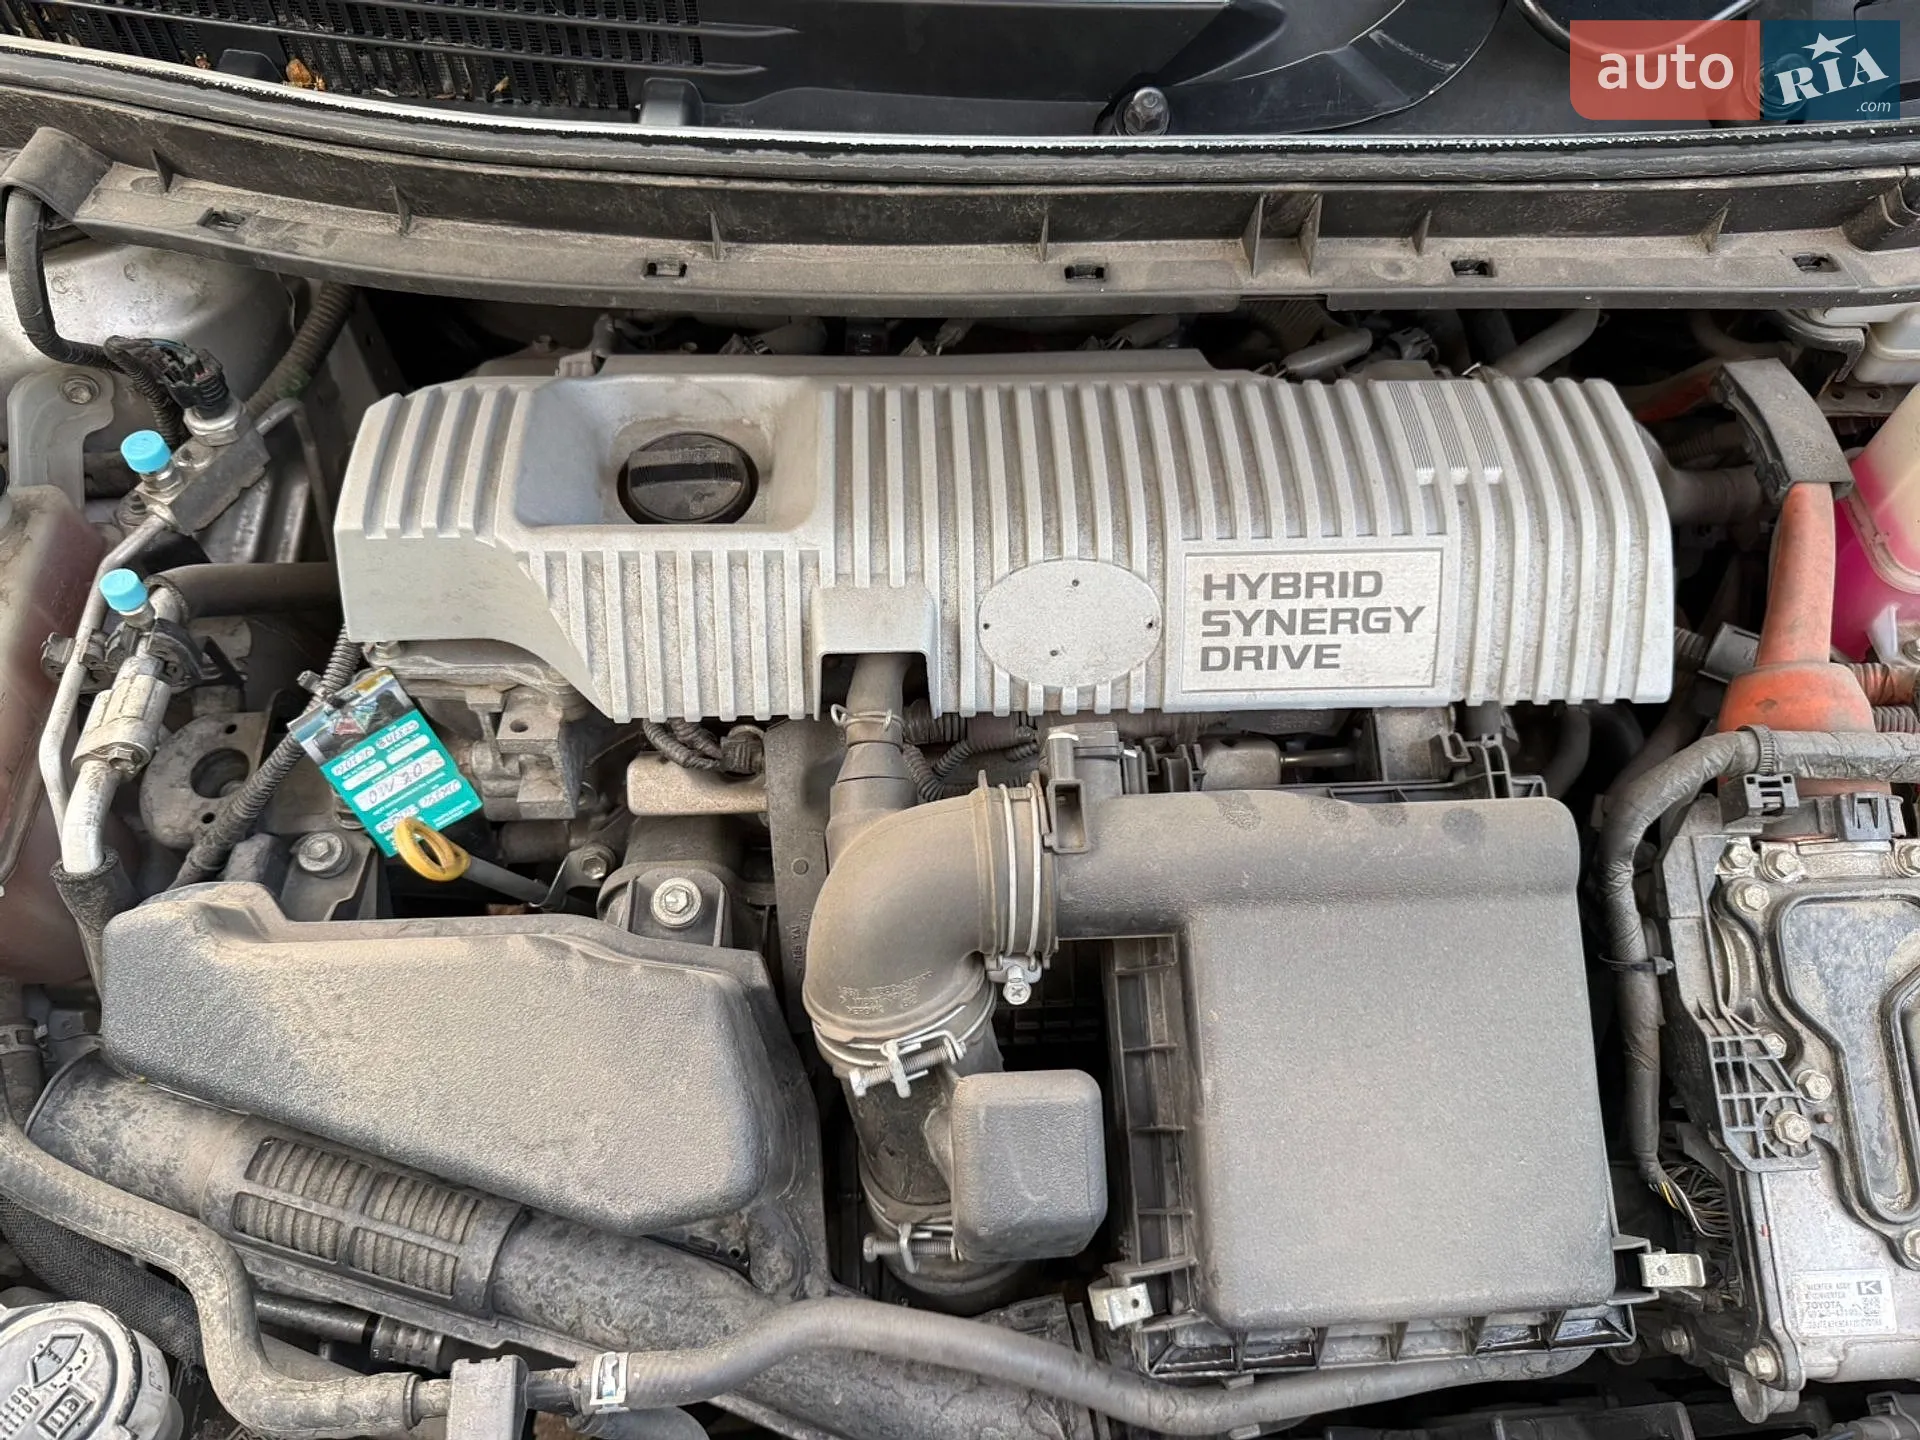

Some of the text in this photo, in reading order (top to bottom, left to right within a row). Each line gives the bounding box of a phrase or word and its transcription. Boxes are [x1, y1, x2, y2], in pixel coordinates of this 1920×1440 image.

[1202, 570, 1383, 601] HYBRID
[1201, 606, 1426, 637] SYNERGY
[1199, 643, 1342, 672] DRIVE
